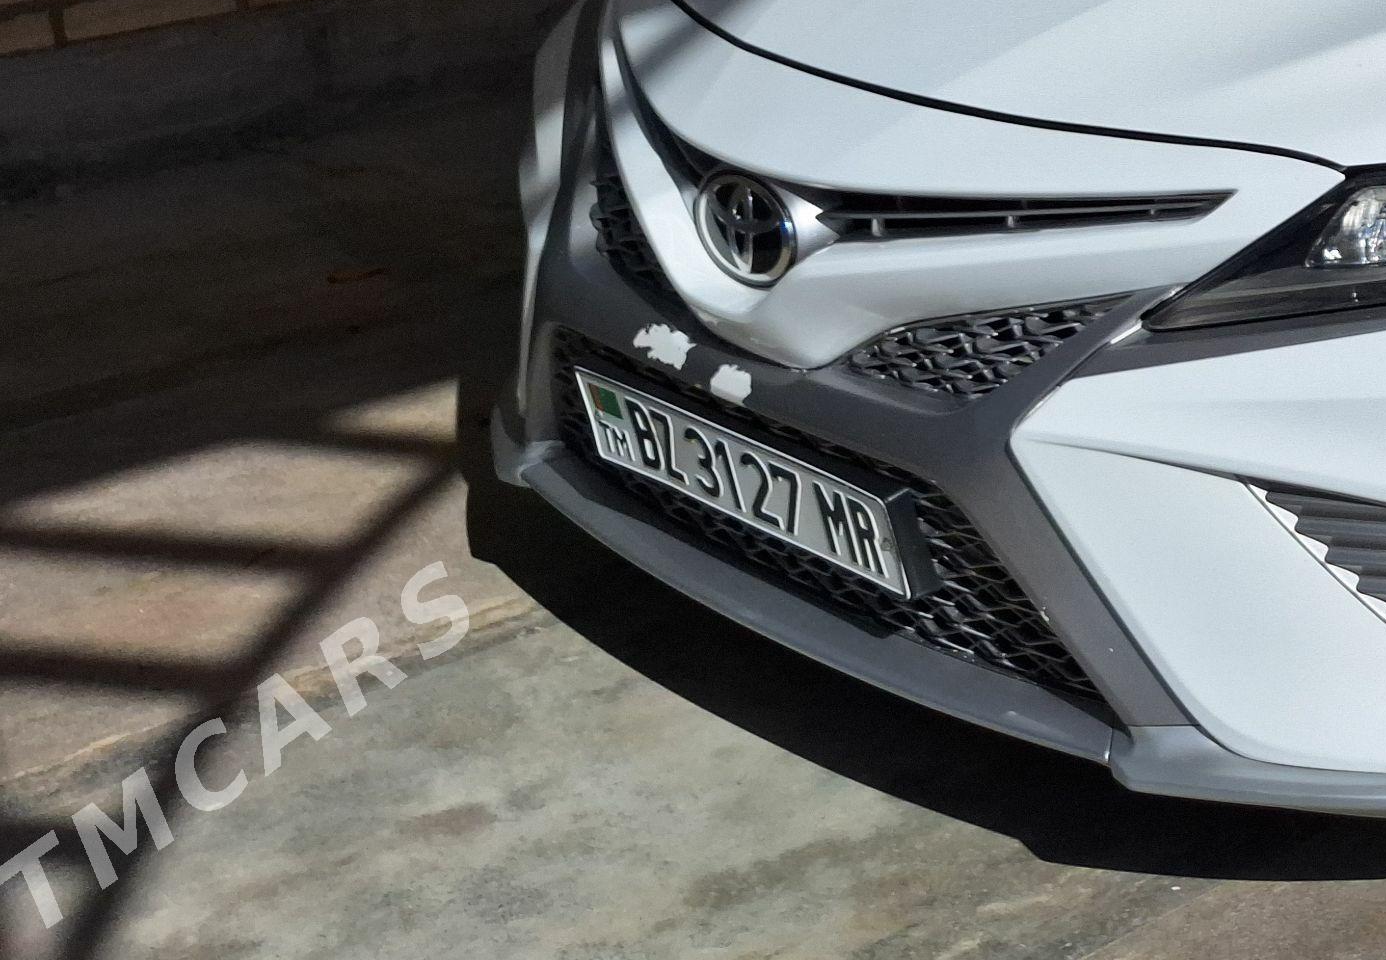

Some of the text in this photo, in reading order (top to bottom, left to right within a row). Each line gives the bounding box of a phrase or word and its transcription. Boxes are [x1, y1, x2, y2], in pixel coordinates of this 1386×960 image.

[599, 420, 636, 462] TM
[625, 396, 890, 579] BZ 3127 MR
